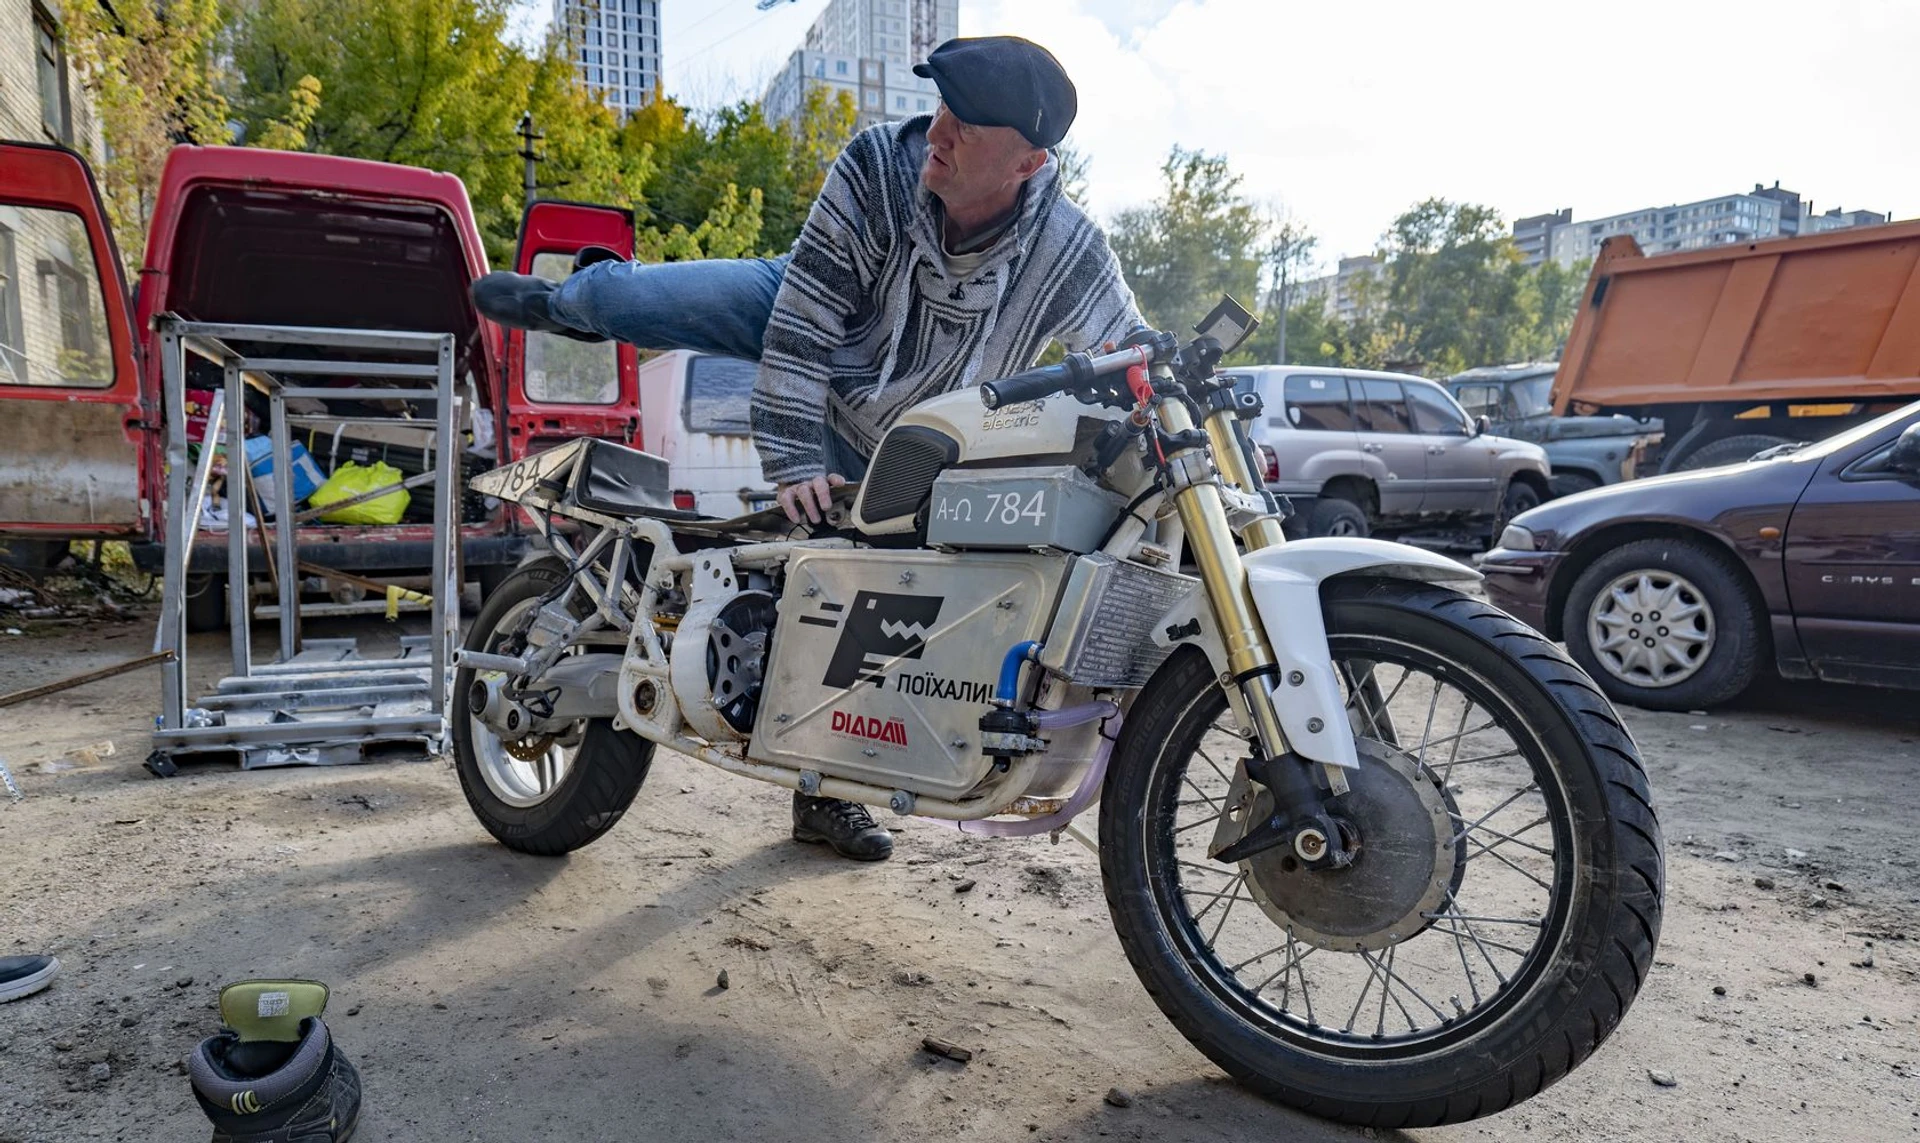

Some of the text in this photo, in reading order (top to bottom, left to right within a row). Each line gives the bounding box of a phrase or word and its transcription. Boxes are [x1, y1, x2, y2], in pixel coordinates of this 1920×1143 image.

[982, 414, 1040, 431] electric
[498, 458, 541, 497] 784
[984, 490, 1047, 526] 784
[897, 672, 993, 705] ПОЇХАЛИ!
